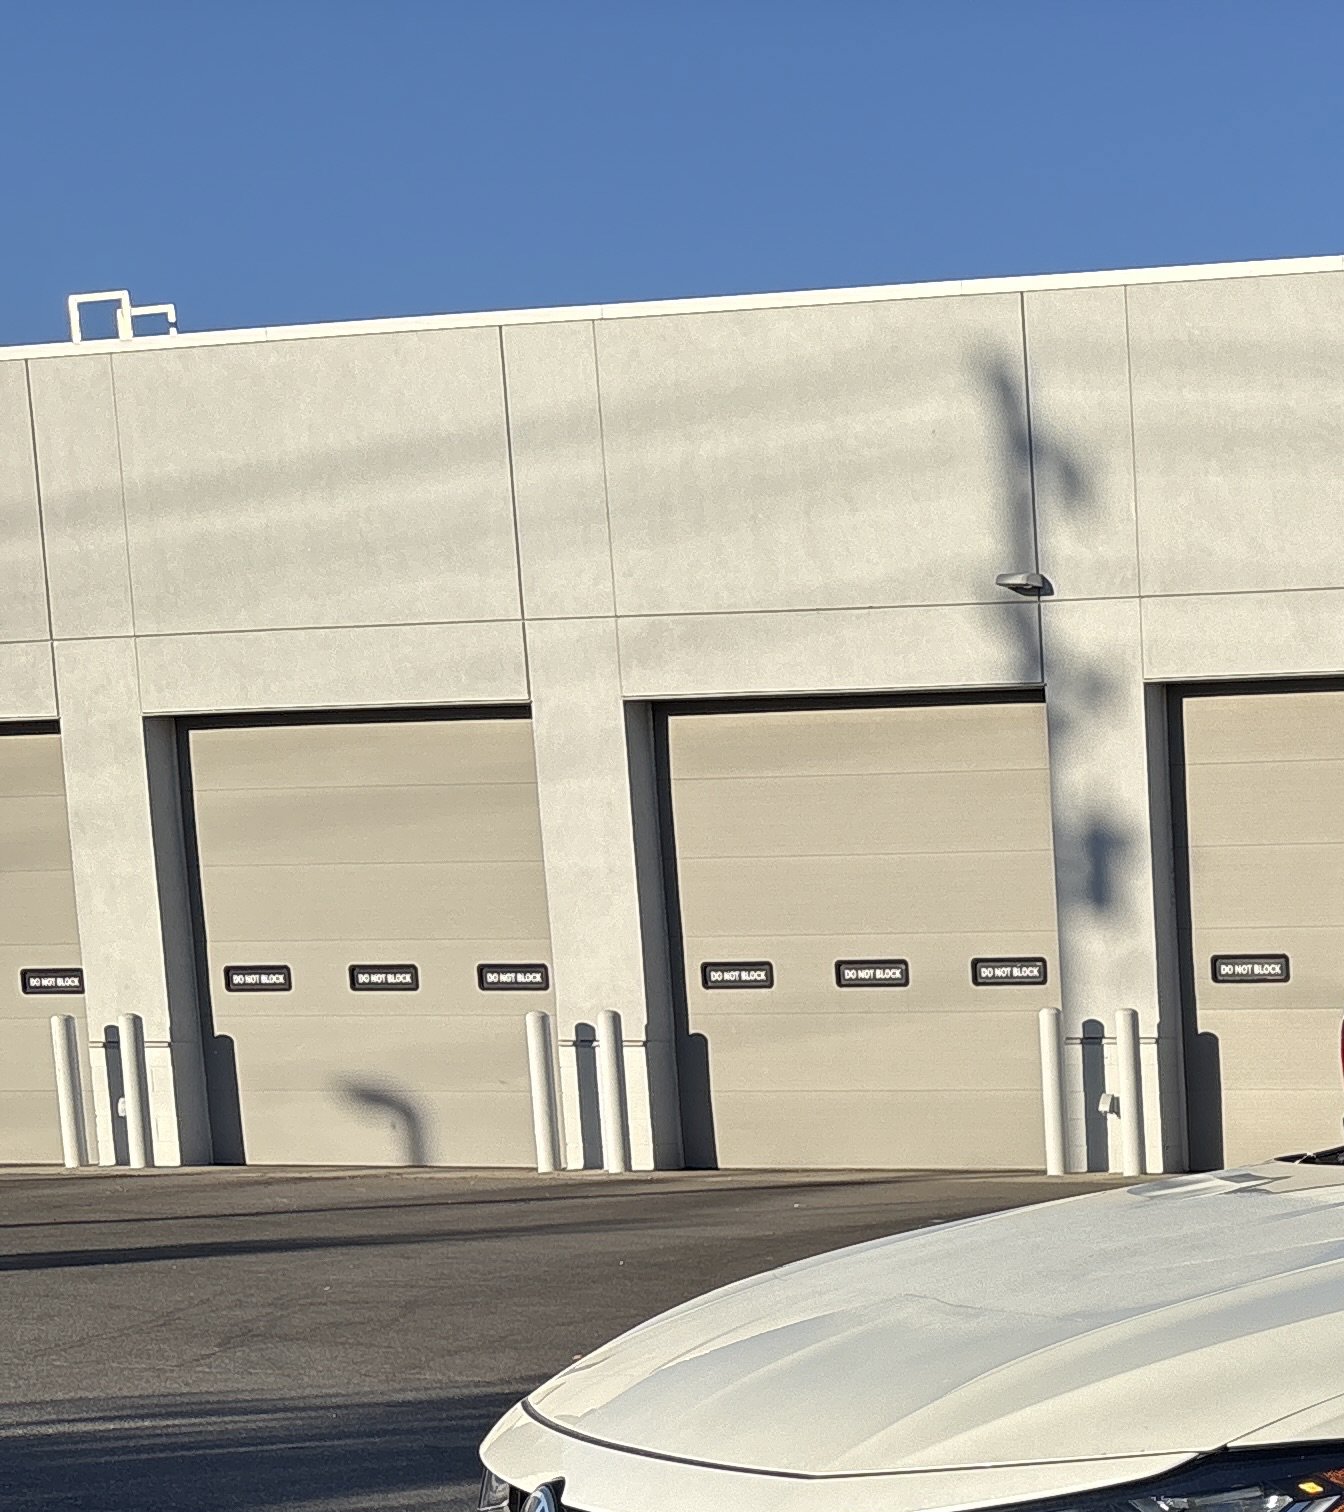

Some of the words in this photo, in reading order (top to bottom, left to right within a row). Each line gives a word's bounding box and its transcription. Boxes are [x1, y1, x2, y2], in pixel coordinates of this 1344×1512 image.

[845, 968, 856, 980] DO
[857, 968, 874, 980] NOT
[875, 968, 901, 980] BLOCK
[981, 966, 993, 978] DO
[994, 966, 1011, 978] NOT
[1012, 966, 1039, 978] BLOCK
[1221, 963, 1233, 975] DO
[1234, 963, 1252, 975] NOT
[1253, 963, 1281, 975] BLOCK
[232, 973, 244, 984] DO
[244, 973, 259, 984] NOT
[260, 973, 284, 984] BLOCK
[357, 973, 369, 984] DO
[370, 973, 386, 984] NOT
[386, 973, 412, 984] BLOCK
[486, 972, 498, 983] DO
[499, 972, 515, 983] NOT
[516, 972, 542, 983] BLOCK
[711, 970, 722, 981] DO
[723, 970, 740, 981] NOT
[741, 970, 766, 981] BLOCK
[29, 976, 41, 987] DO
[41, 976, 55, 987] NOT
[56, 976, 80, 987] BLOCK
